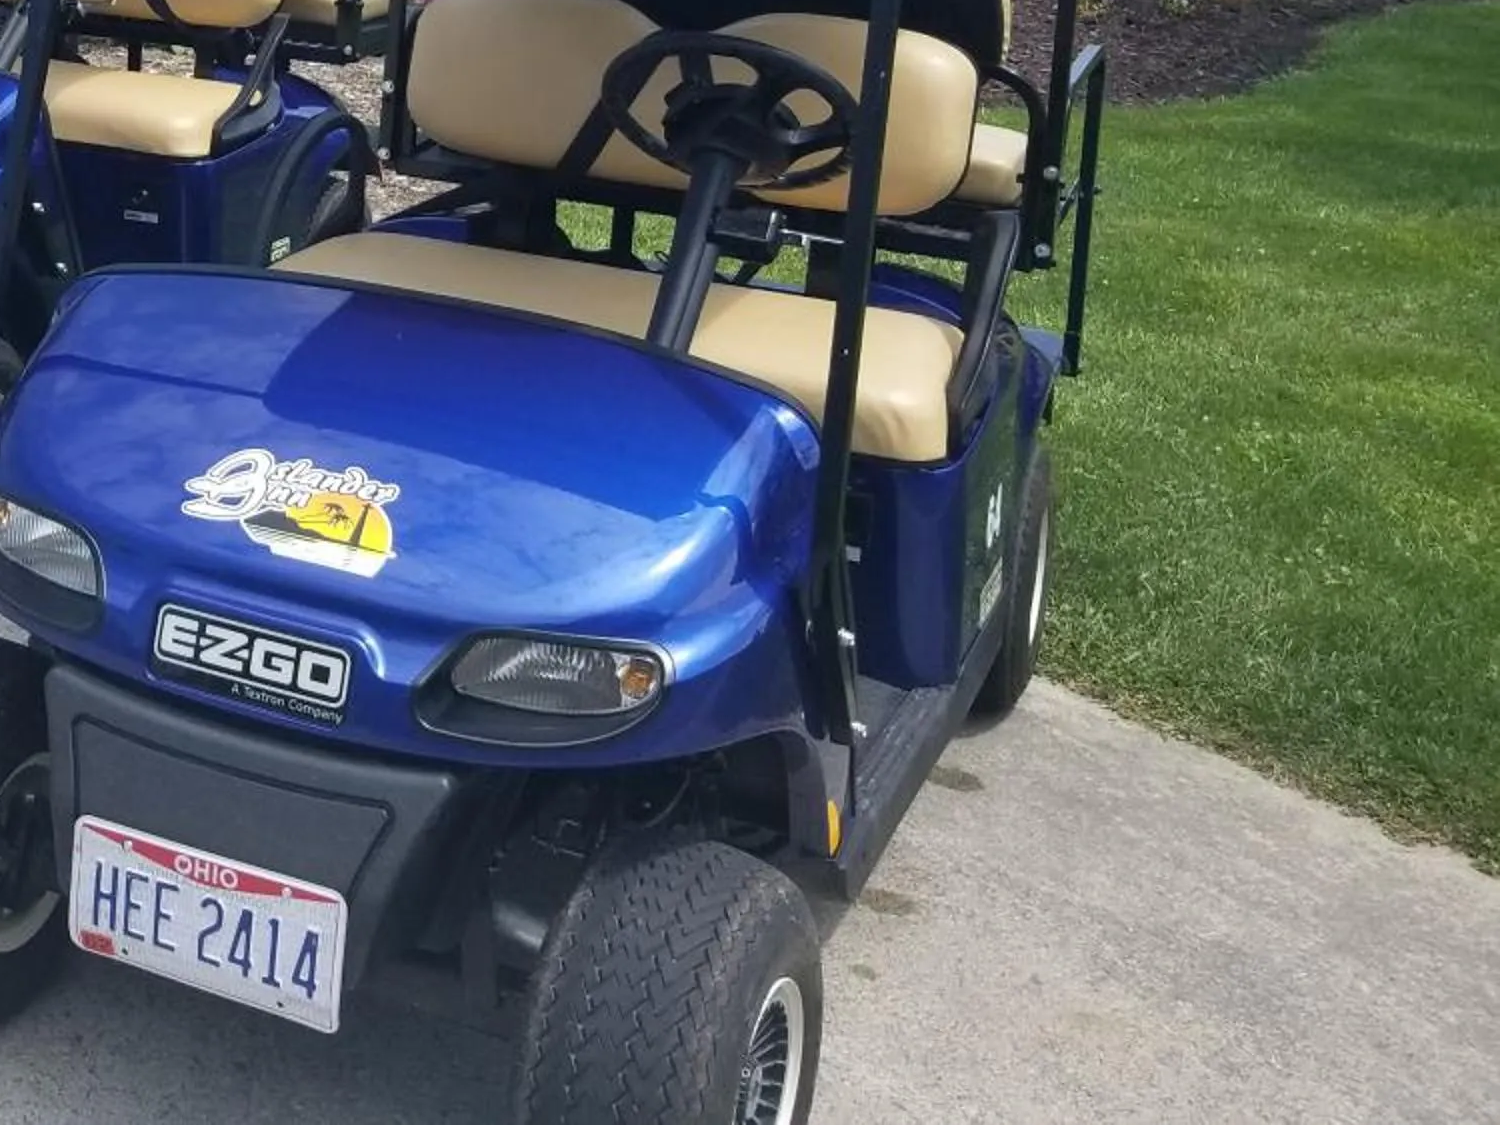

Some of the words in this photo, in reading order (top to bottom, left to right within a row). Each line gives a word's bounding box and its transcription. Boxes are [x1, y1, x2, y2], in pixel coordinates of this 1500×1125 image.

[231, 683, 240, 695] A
[243, 685, 285, 706] Textron
[288, 698, 343, 725] Company
[173, 854, 239, 889] OHIO
[93, 861, 180, 952] HEE
[197, 897, 319, 1000] 2414
